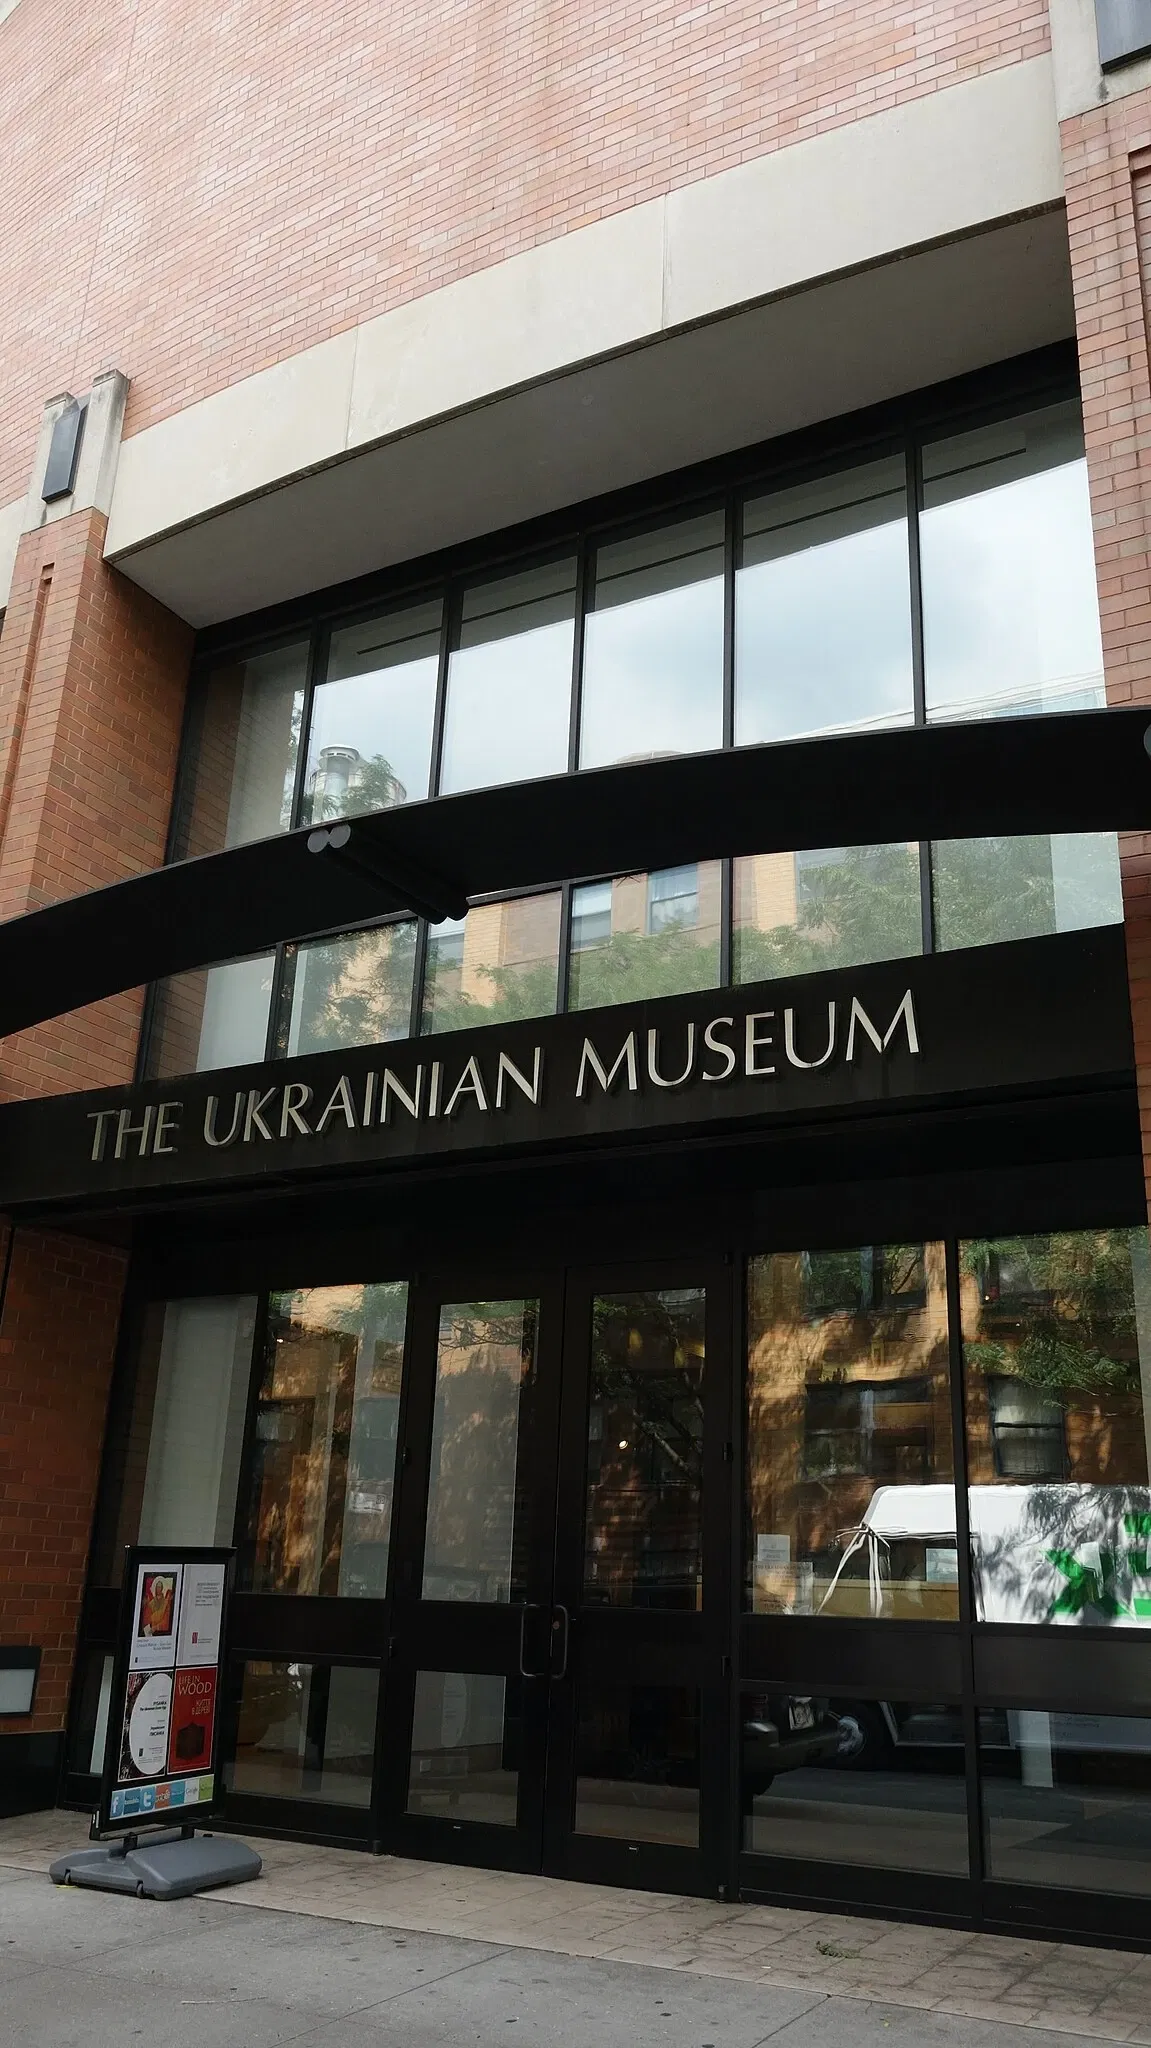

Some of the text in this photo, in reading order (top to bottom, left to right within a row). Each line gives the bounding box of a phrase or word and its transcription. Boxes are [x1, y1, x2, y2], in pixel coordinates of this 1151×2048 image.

[86, 988, 920, 1162] THE UKRAINIAN MUSEUM
[178, 1675, 201, 1685] LIFE IN
[178, 1681, 212, 1696] WOOD
